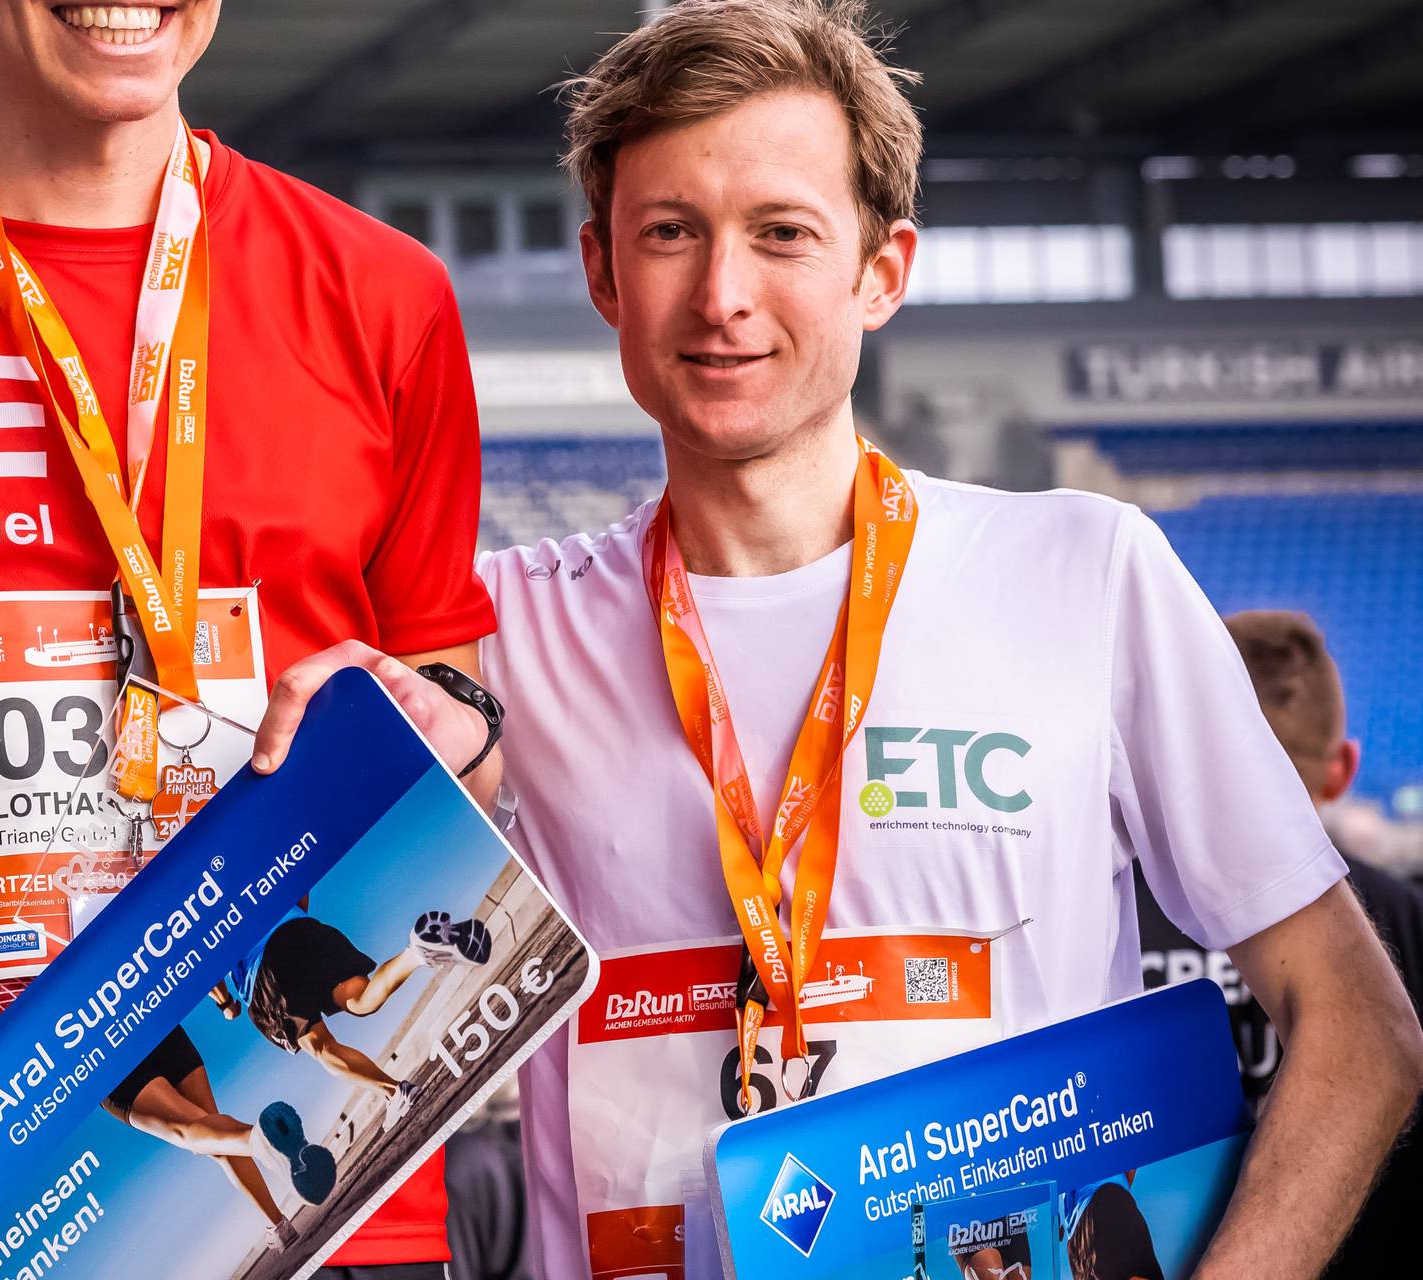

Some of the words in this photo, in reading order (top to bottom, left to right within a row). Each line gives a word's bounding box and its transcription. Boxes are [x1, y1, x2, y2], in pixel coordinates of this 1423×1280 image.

[9, 252, 45, 307] AK
[177, 359, 196, 411] B2Run
[184, 415, 196, 443] DAK
[123, 546, 143, 575] DAK
[863, 571, 874, 599] AKTIV
[142, 578, 172, 632] B2Run
[166, 768, 212, 783] B2Run
[166, 784, 212, 795] FINISHER
[864, 727, 1033, 813] ETC
[775, 775, 811, 838] DAK
[781, 783, 818, 841] Gesundheit
[870, 820, 929, 830] enrichment
[932, 821, 989, 834] technology
[991, 825, 1032, 839] company
[743, 897, 761, 927] DAK
[760, 930, 788, 983] B2Run
[8, 1046, 106, 1146] Gutschein
[104, 950, 202, 1048] Einkaufen
[202, 903, 243, 949] und
[240, 831, 318, 906] Tanken
[605, 990, 683, 1020] B2Run
[692, 982, 738, 1001] DAK
[429, 983, 520, 1079] 150
[519, 957, 554, 995] €
[605, 1020, 632, 1030] AACHEN
[674, 1014, 696, 1023] AKTIV
[720, 1040, 837, 1122] 67
[859, 1130, 917, 1185] Aral
[864, 1174, 956, 1223] Gutschein
[960, 1149, 1048, 1190] Einkaufen
[1053, 1128, 1086, 1160] und
[1089, 1108, 1154, 1148] Tanken
[771, 1185, 827, 1223] ARAL
[948, 1220, 1004, 1248] B2Run
[1009, 1209, 1038, 1227] DAK
[4, 1191, 105, 1280] anken!
[948, 1245, 969, 1256] AACHEN
[997, 1238, 1011, 1248] AKTIV
